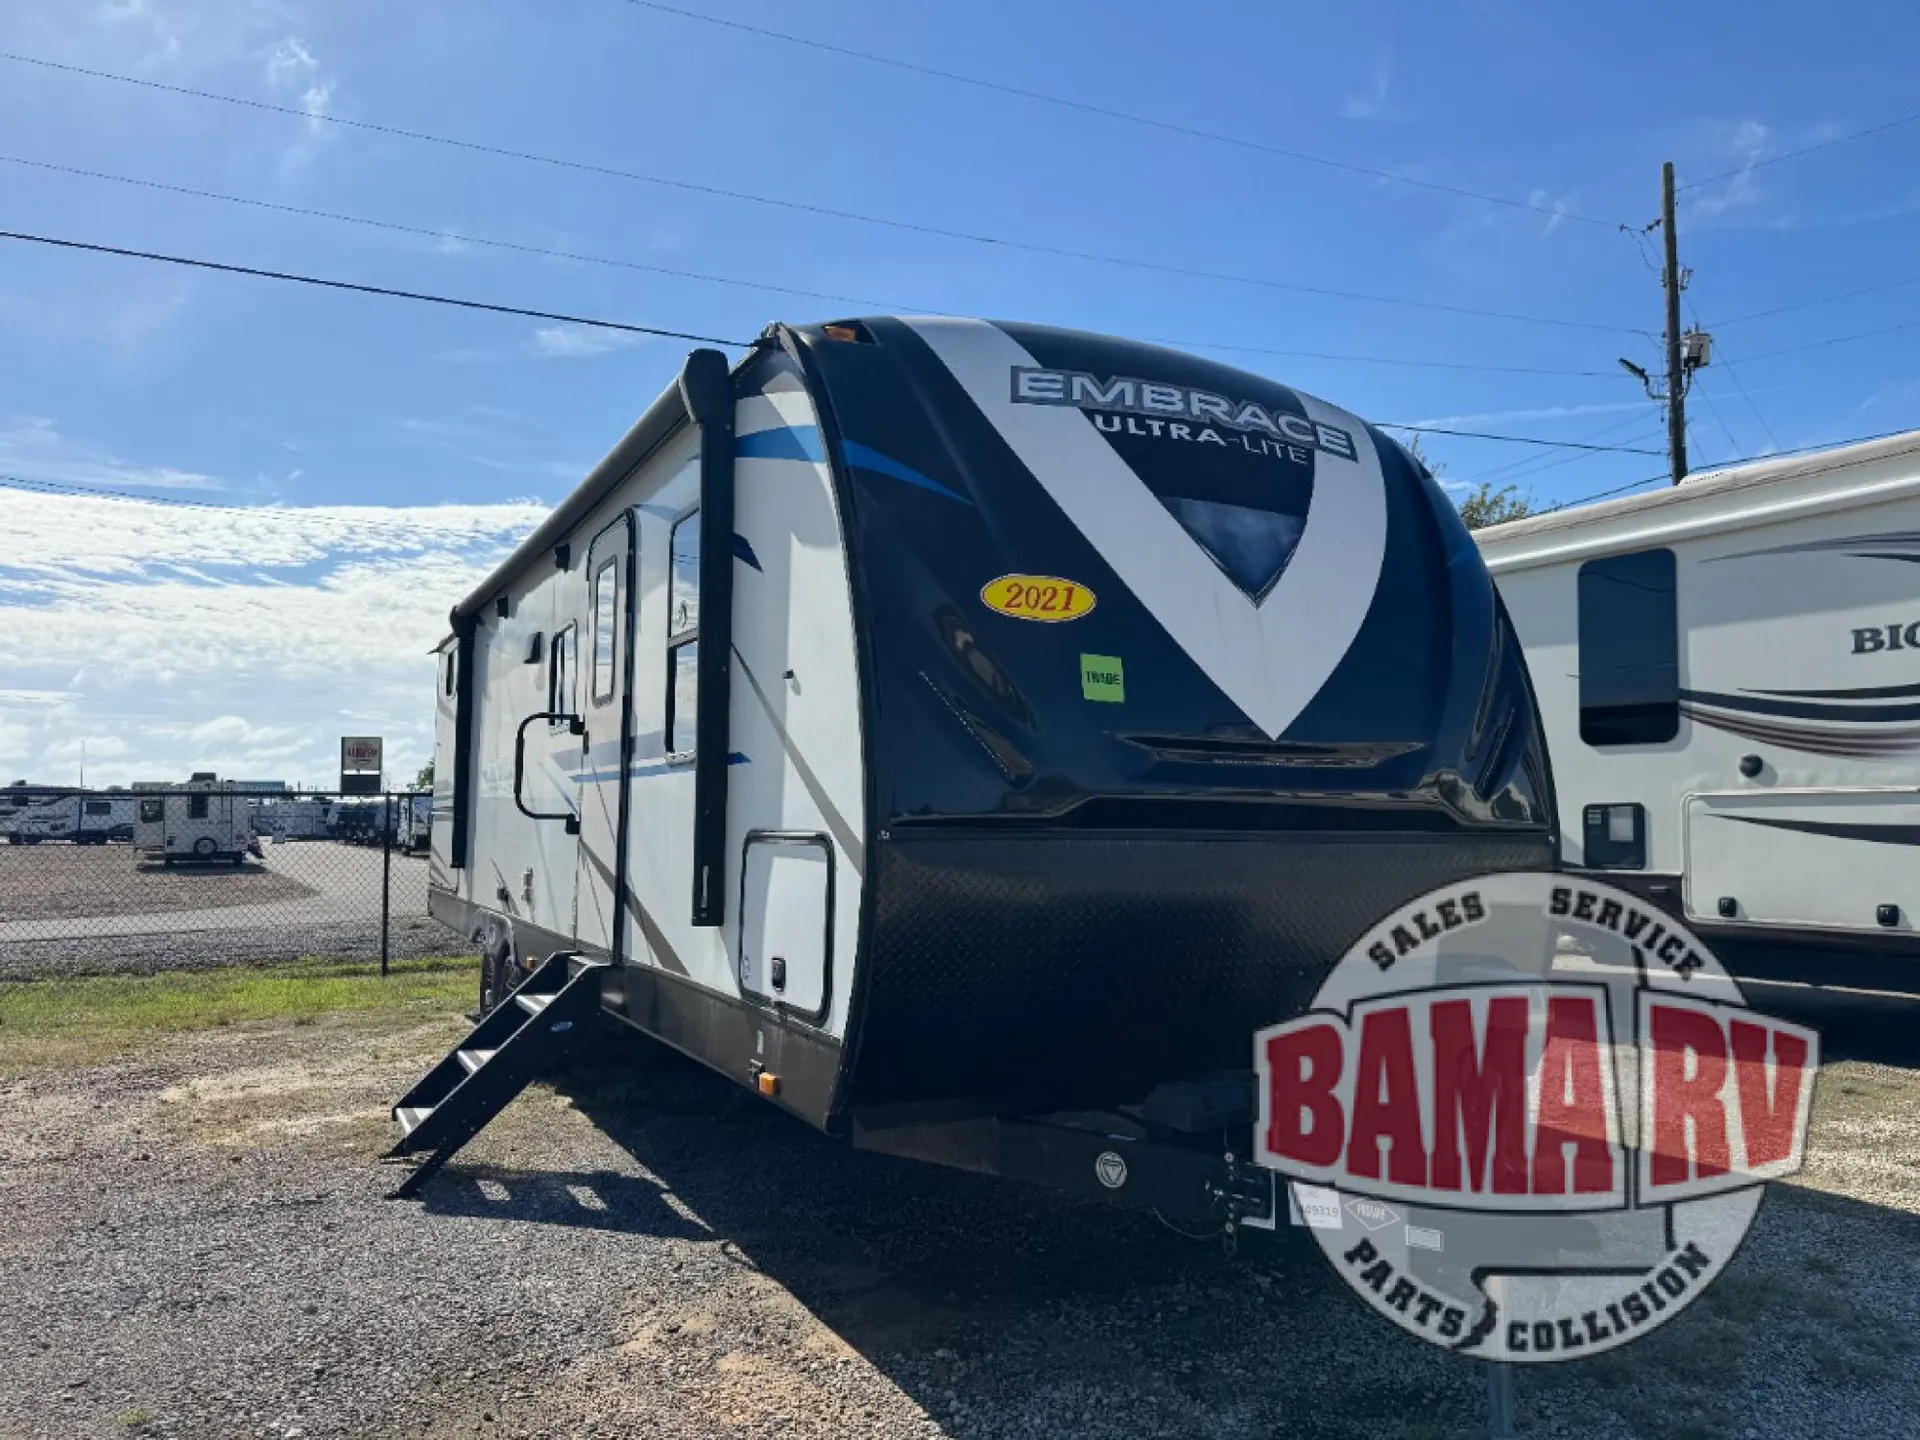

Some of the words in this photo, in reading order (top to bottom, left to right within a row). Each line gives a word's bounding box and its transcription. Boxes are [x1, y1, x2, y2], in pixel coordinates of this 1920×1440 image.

[1014, 369, 1356, 459] EMBRACE
[1096, 413, 1309, 465] ULTRA-LITE
[1004, 582, 1076, 612] 2021
